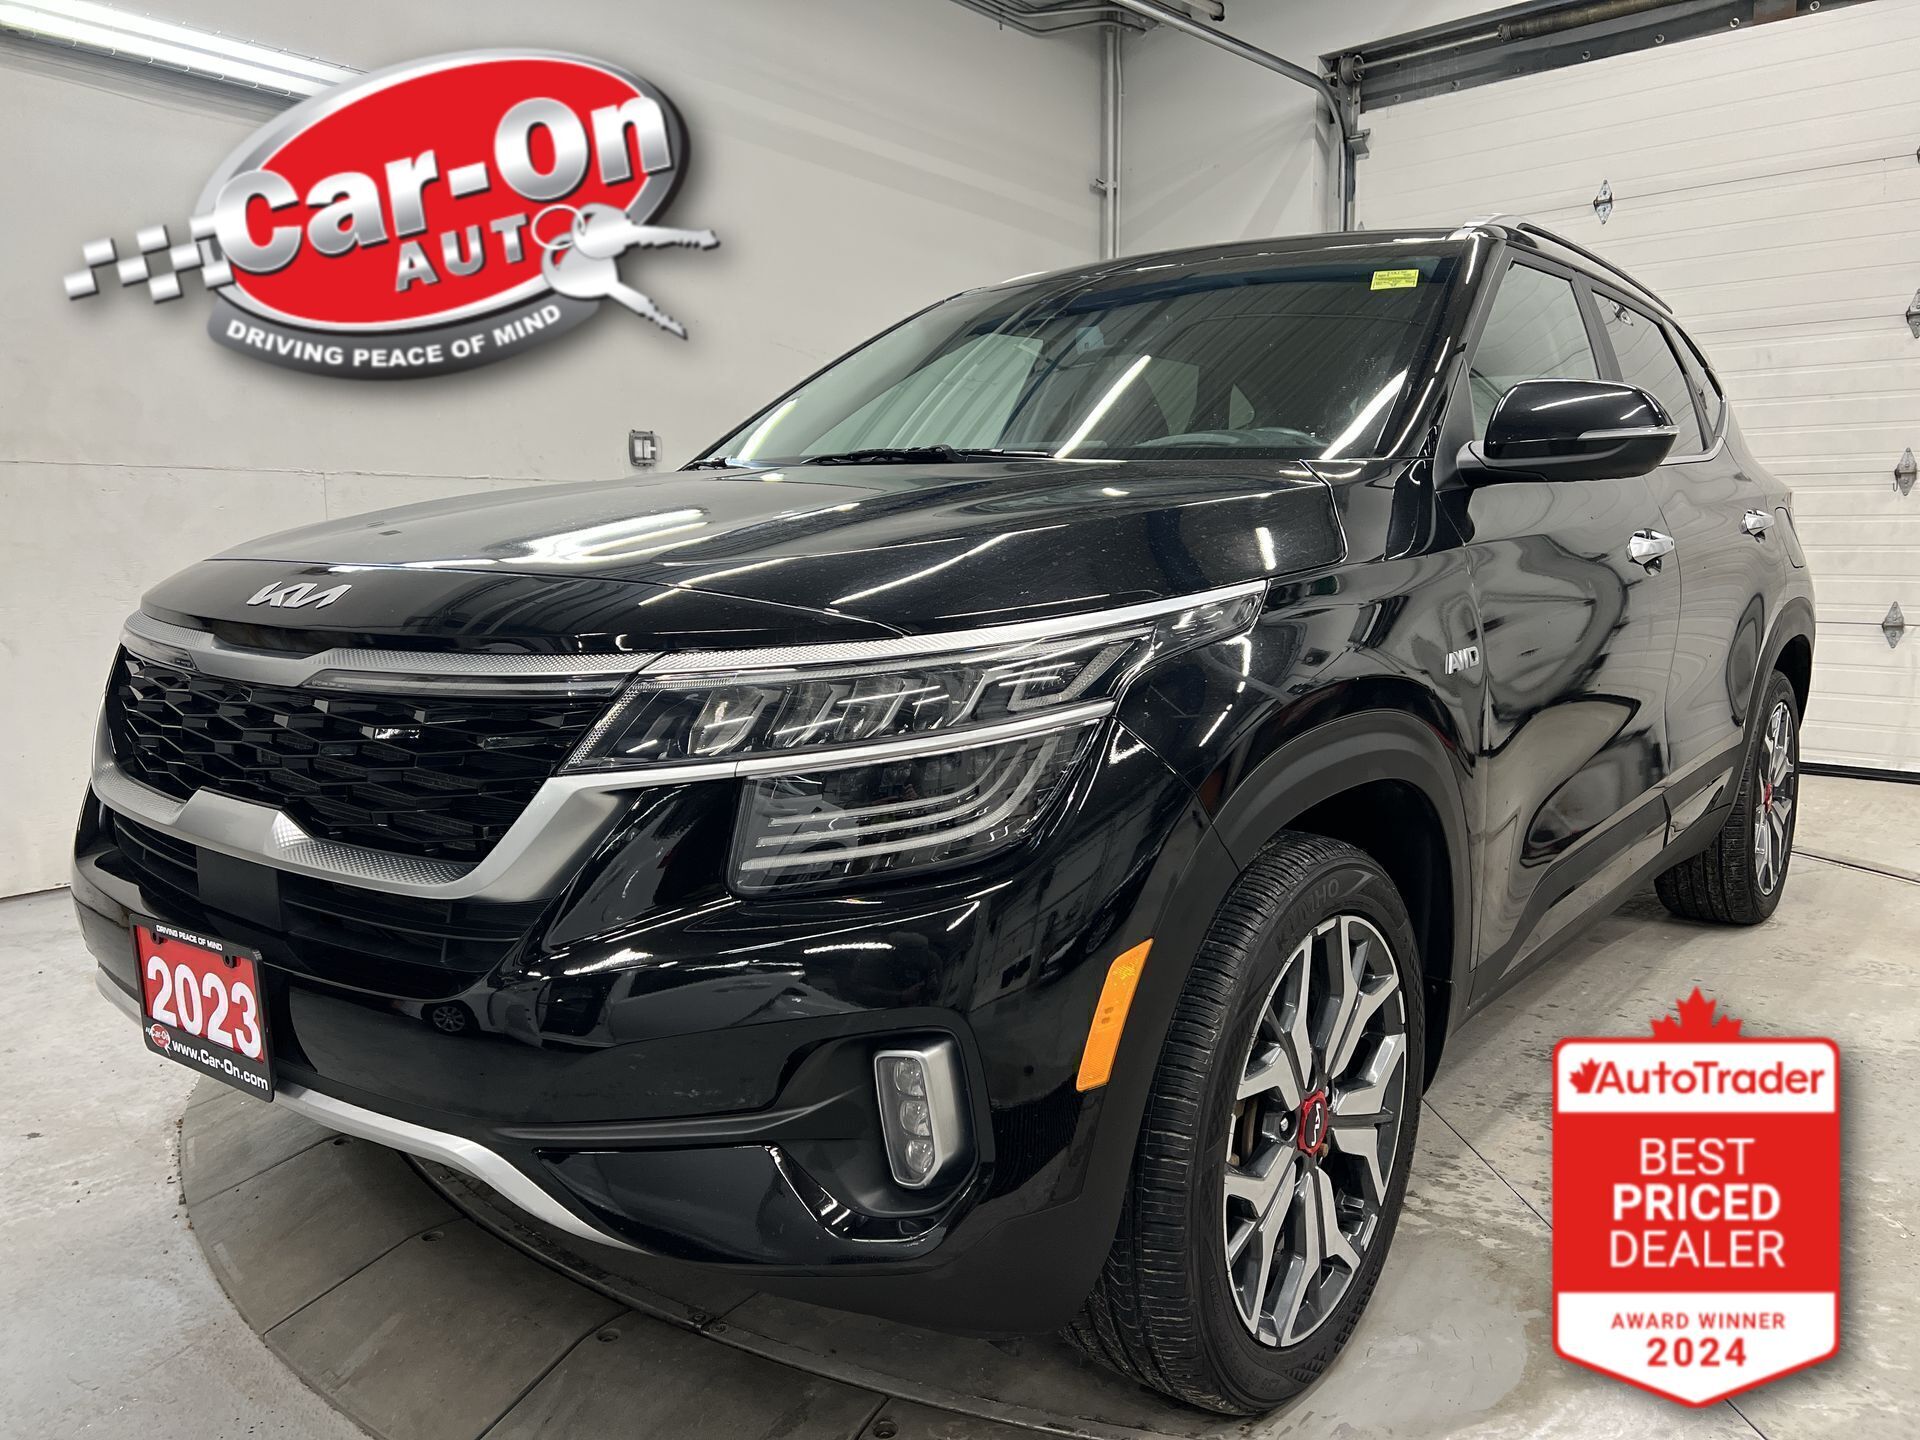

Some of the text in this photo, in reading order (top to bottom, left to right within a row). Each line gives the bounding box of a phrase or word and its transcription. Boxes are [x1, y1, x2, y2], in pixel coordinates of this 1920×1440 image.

[1445, 646, 1480, 675] AWD
[156, 925, 223, 952] DRIVING PEACE OF MIND
[147, 955, 262, 1059] 2023
[172, 1040, 269, 1091] www.Car-On.com
